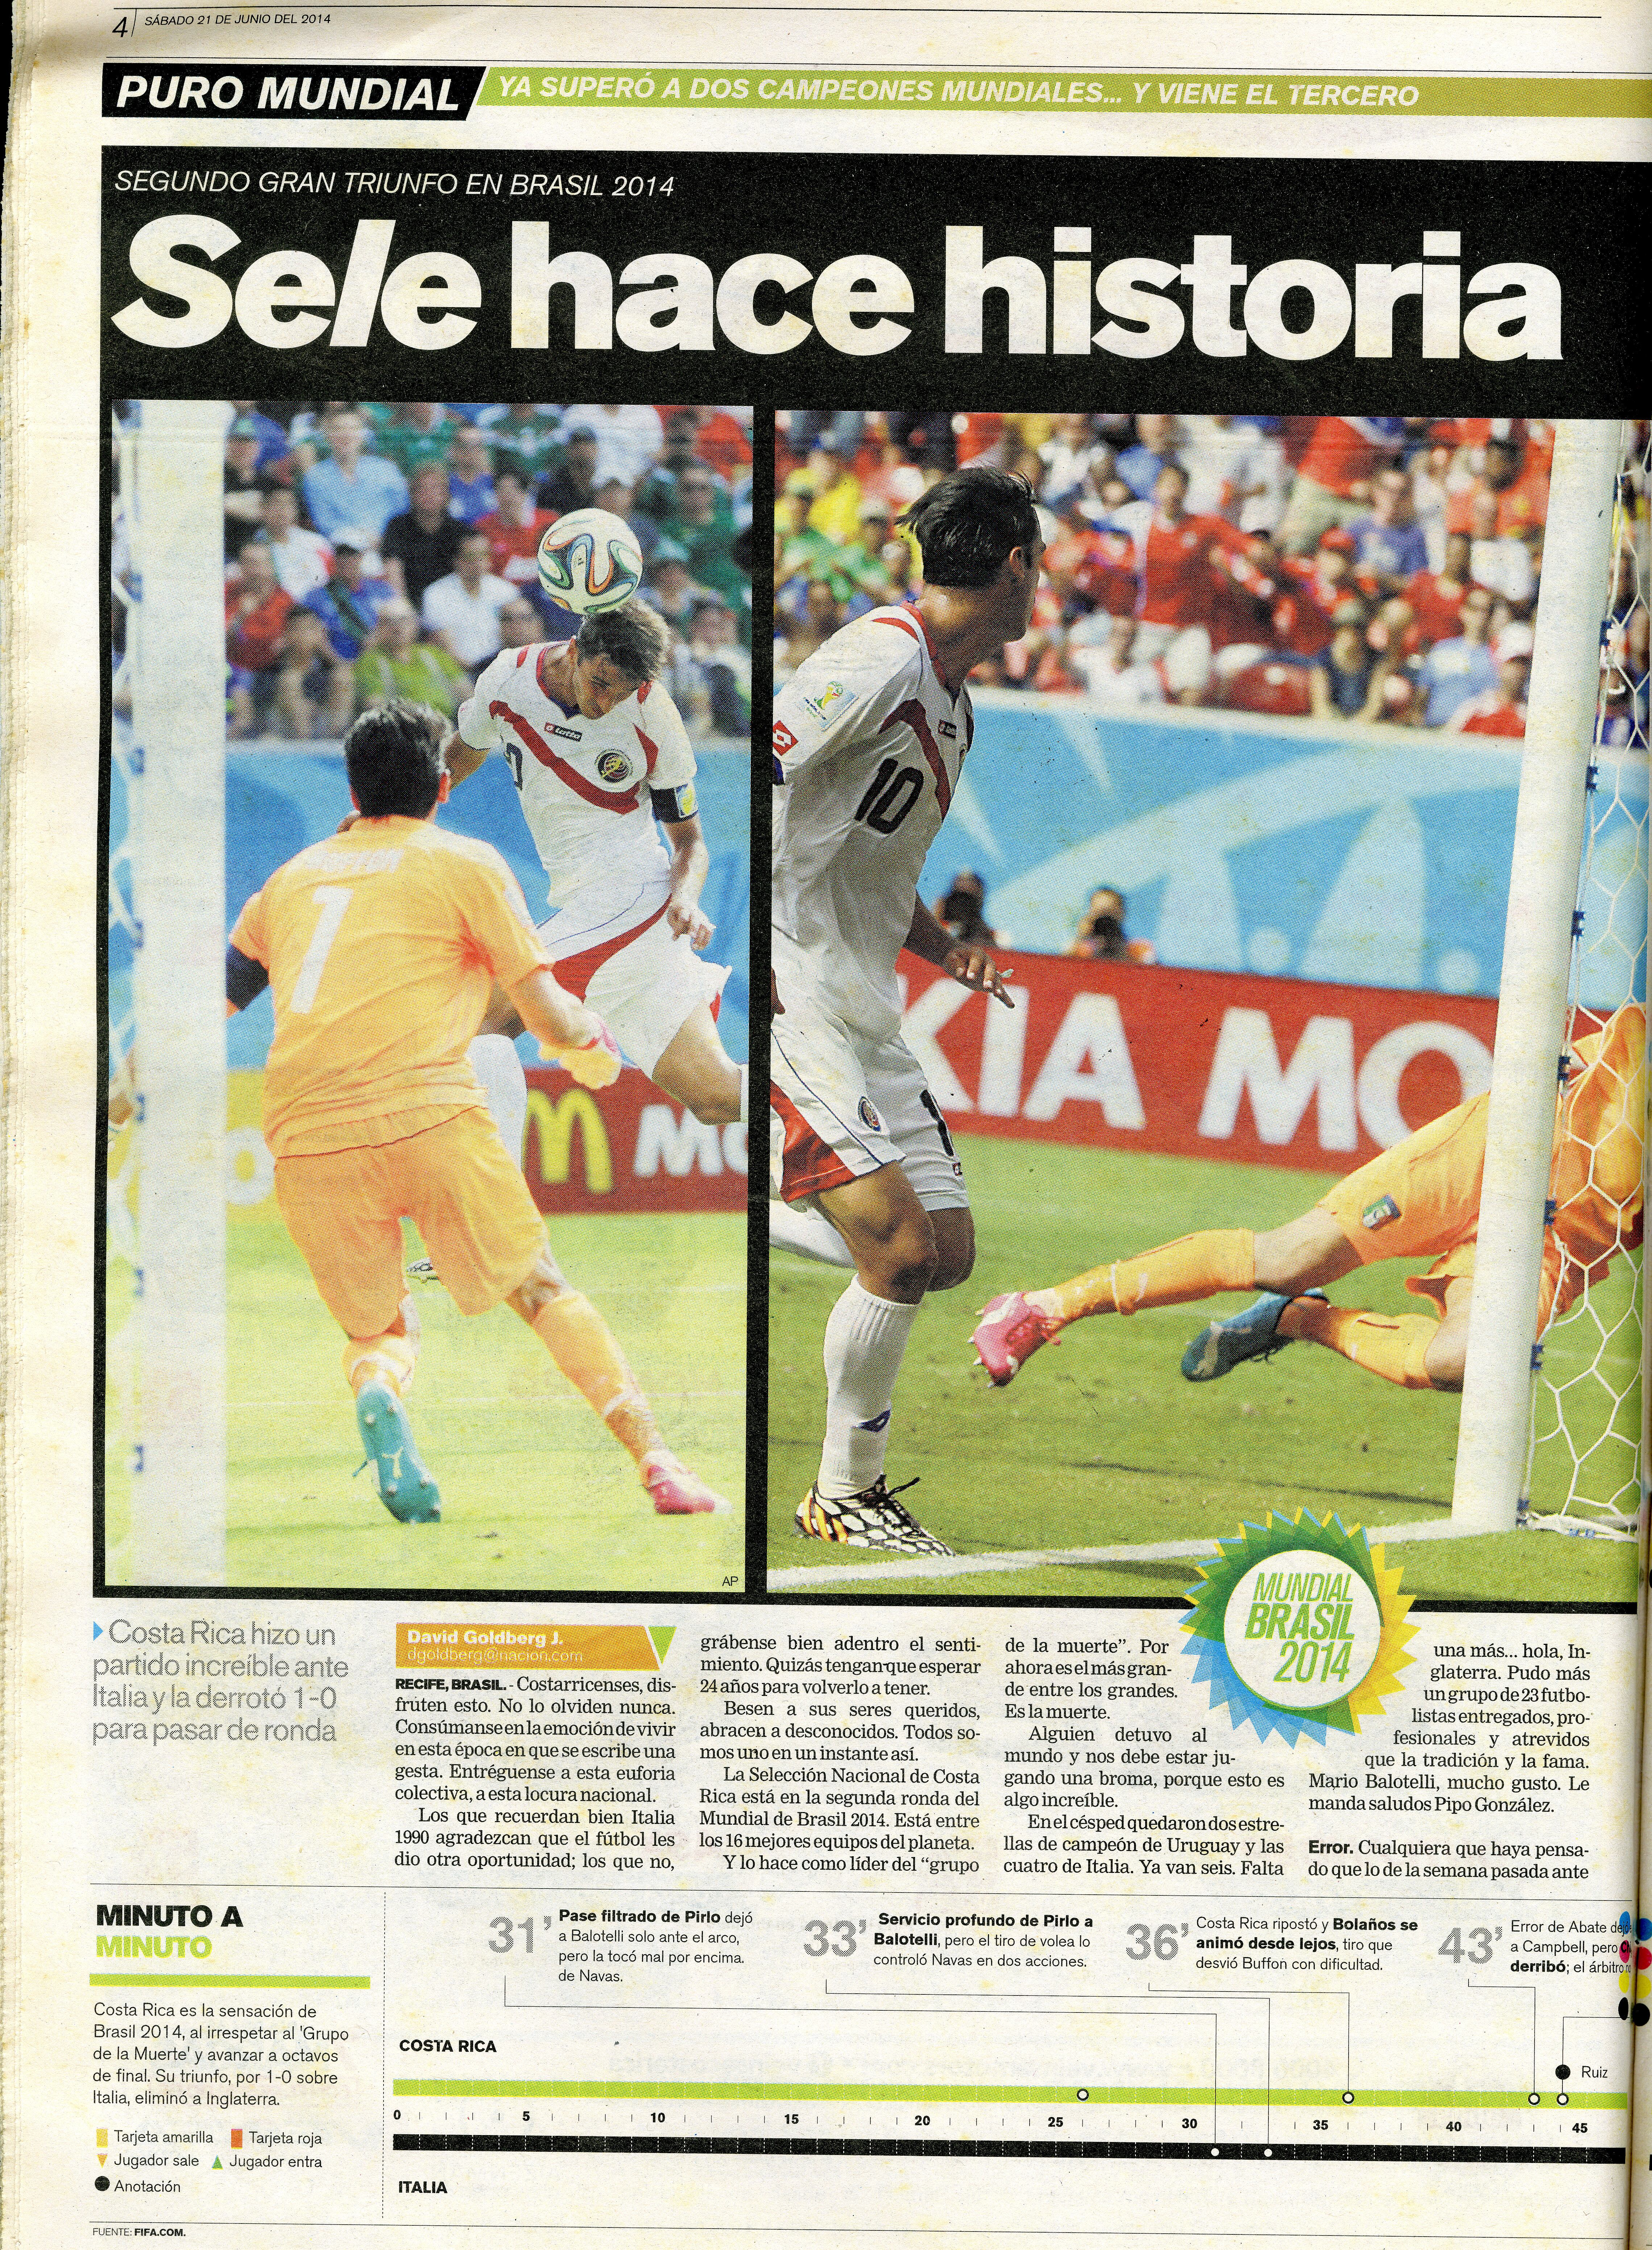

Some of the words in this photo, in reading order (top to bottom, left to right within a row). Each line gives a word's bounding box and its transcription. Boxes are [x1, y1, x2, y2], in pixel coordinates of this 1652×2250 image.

[112, 17, 128, 37] 4
[145, 15, 194, 25] SÁBADO
[197, 16, 210, 24] 21
[215, 15, 232, 24] DE
[235, 15, 270, 24] JUNIO
[274, 14, 297, 23] DEL
[302, 14, 330, 23] 2014
[117, 76, 243, 109] PURO
[258, 77, 458, 110] MUNDIAL
[500, 76, 531, 97] YA
[540, 73, 655, 98] SUPERÓ
[662, 78, 681, 99] A
[690, 78, 749, 99] DOS
[757, 79, 933, 102] CAMPEONES
[942, 80, 1123, 104] MUNDIALES...
[1133, 82, 1151, 104] Y
[1158, 83, 1239, 104] VIENE
[1247, 84, 1279, 105] EL
[1288, 84, 1420, 107] TERCERO
[115, 170, 250, 192] SEGUNDO
[259, 171, 335, 193] GRAN
[345, 172, 457, 194] TRIUNFO
[466, 174, 502, 194] EN
[510, 174, 603, 195] BRASIL
[612, 176, 674, 196] 2014
[111, 214, 481, 350] Sele
[511, 221, 914, 356] hace
[945, 226, 1562, 361] historia
[854, 758, 924, 834] 10
[291, 885, 354, 1014] 1
[898, 976, 1147, 1130] KIA
[722, 1576, 738, 1586] AP
[1253, 1572, 1353, 1602] MUNDIAL
[1244, 1602, 1355, 1641] BRASIL
[109, 1619, 186, 1644] Costa
[191, 1620, 246, 1645] Rica
[251, 1621, 300, 1646] hizo
[306, 1629, 335, 1646] un
[408, 1630, 460, 1644] David
[464, 1631, 546, 1647] Goldberg
[551, 1631, 563, 1645] J.
[701, 1634, 776, 1651] grábense
[787, 1635, 824, 1650] bien
[835, 1636, 899, 1650] adentro
[910, 1637, 924, 1651] el
[935, 1637, 981, 1651] senti-
[1006, 1638, 1024, 1652] de
[1033, 1638, 1048, 1652] la
[1057, 1639, 1130, 1653] muerte”.
[1140, 1639, 1169, 1653] Por
[1434, 1646, 1466, 1657] una
[1470, 1643, 1517, 1658] más...
[1523, 1643, 1563, 1660] hola,
[1568, 1644, 1590, 1658] In-
[408, 1647, 583, 1664] dgoldberg@nacion.com
[1273, 1641, 1350, 1683] 2014
[93, 1652, 180, 1682] partido
[186, 1653, 289, 1677] increíble
[294, 1657, 348, 1678] ante
[93, 1683, 149, 1708] Italia
[152, 1691, 165, 1715] y
[171, 1684, 191, 1708] la
[195, 1684, 286, 1710] derrotó
[295, 1686, 337, 1710] 1-0
[396, 1697, 448, 1712] fruten
[454, 1699, 490, 1712] esto.
[499, 1699, 522, 1712] No
[529, 1699, 544, 1713] lo
[551, 1699, 613, 1713] olviden
[620, 1703, 675, 1714] nunca.
[724, 1701, 774, 1715] Besen
[787, 1705, 796, 1716] a
[810, 1705, 836, 1716] sus
[850, 1706, 891, 1716] seres
[905, 1703, 980, 1720] queridos,
[93, 1722, 148, 1745] para
[153, 1722, 223, 1746] pasar
[227, 1717, 259, 1741] de
[265, 1717, 337, 1742] ronda
[1005, 1770, 1055, 1787] gando
[1061, 1774, 1093, 1785] una
[1099, 1770, 1157, 1788] broma,
[1164, 1775, 1222, 1789] porque
[1228, 1773, 1261, 1787] esto
[1268, 1777, 1284, 1787] es
[1309, 1773, 1358, 1790] Mario
[1366, 1774, 1439, 1791] Balotelli,
[1448, 1775, 1504, 1790] mucho
[1512, 1777, 1560, 1793] gusto.
[1569, 1776, 1589, 1790] Le
[419, 1808, 448, 1822] Los
[457, 1812, 487, 1825] que
[495, 1809, 580, 1823] recuerdan
[588, 1809, 624, 1824] bien
[632, 1810, 675, 1824] Italia
[1309, 1840, 1353, 1854] Error.
[1359, 1840, 1451, 1857] Cualquiera
[1456, 1845, 1486, 1858] que
[1491, 1841, 1531, 1858] haya
[1535, 1846, 1589, 1859] pensa-
[97, 1905, 212, 1927] MINUTO
[221, 1906, 243, 1927] A
[560, 1910, 596, 1921] Pase
[601, 1910, 656, 1922] filtrado
[662, 1911, 680, 1922] de
[686, 1911, 720, 1923] Pirlo
[725, 1911, 752, 1927] dejó
[879, 1913, 940, 1925] Servicio
[946, 1914, 1015, 1928] profundo
[1020, 1915, 1038, 1926] de
[1044, 1915, 1079, 1927] Pirlo
[1085, 1918, 1093, 1927] a
[96, 1935, 212, 1959] MINUTO
[94, 2002, 137, 2016] Costa
[143, 2002, 175, 2016] Rica
[180, 2007, 196, 2017] es
[203, 2003, 214, 2017] la
[219, 2004, 293, 2017] sensación
[298, 2005, 316, 2018] de
[399, 2039, 453, 2052] COSTA
[459, 2040, 497, 2052] RICA
[1582, 2066, 1607, 2078] Ruiz
[394, 2110, 401, 2119] 0
[523, 2111, 530, 2121] 5
[651, 2113, 665, 2122] 10
[785, 2114, 799, 2124] 15
[915, 2115, 930, 2125] 20
[1048, 2117, 1063, 2127] 25
[1182, 2118, 1197, 2128] 30
[1313, 2120, 1328, 2130] 35
[1446, 2122, 1461, 2131] 40
[1572, 2123, 1587, 2133] 45
[114, 2130, 158, 2146] Tarjeta
[163, 2131, 213, 2143] amarilla
[249, 2131, 293, 2147] Tarjeta
[298, 2135, 322, 2148] roja
[114, 2154, 169, 2169] Jugador
[173, 2154, 199, 2166] sale
[230, 2155, 284, 2170] Jugador
[288, 2156, 322, 2167] entra
[399, 2181, 447, 2193] ITALIA
